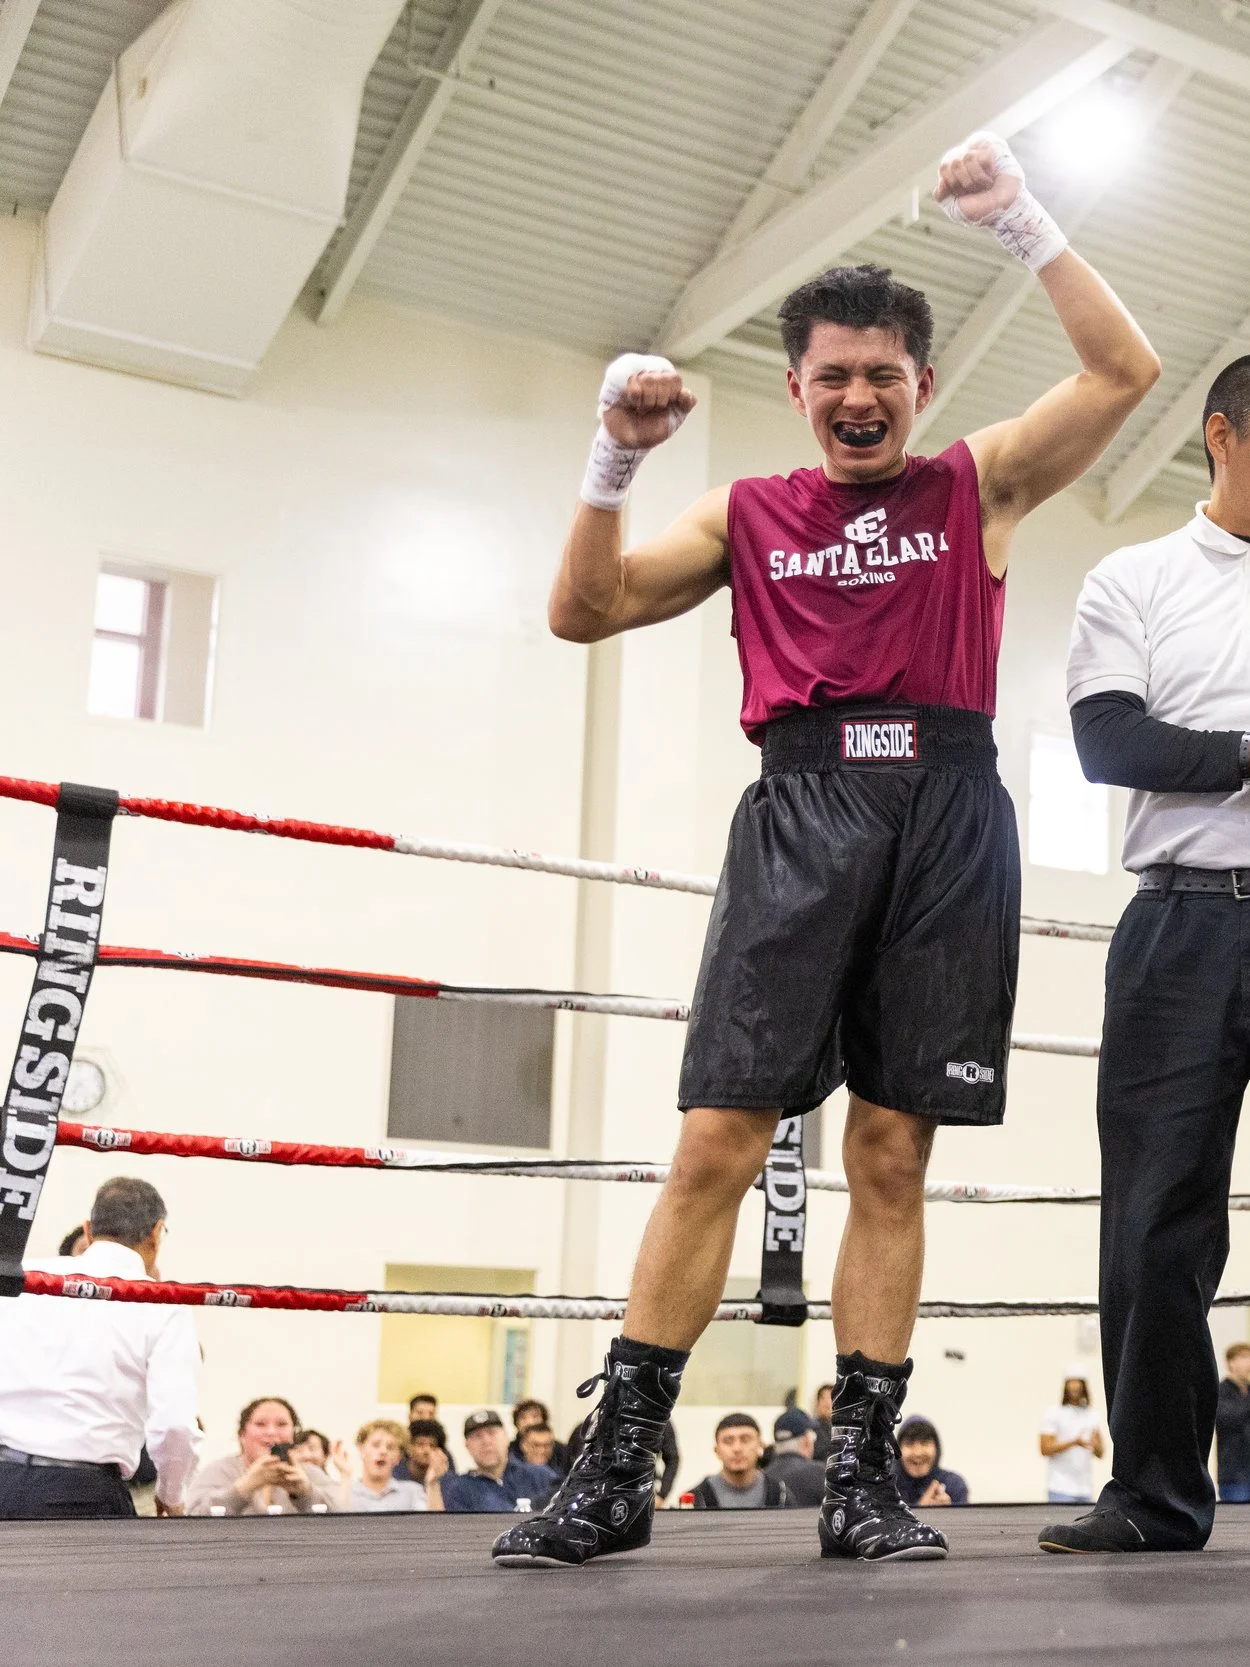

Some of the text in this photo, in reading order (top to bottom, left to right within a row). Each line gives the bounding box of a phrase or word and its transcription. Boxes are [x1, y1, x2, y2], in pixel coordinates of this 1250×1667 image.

[769, 544, 862, 581] SANTA
[837, 571, 896, 587] BOXING
[845, 723, 914, 758] RINGSIDE
[0, 857, 107, 1221] RINGSIDE
